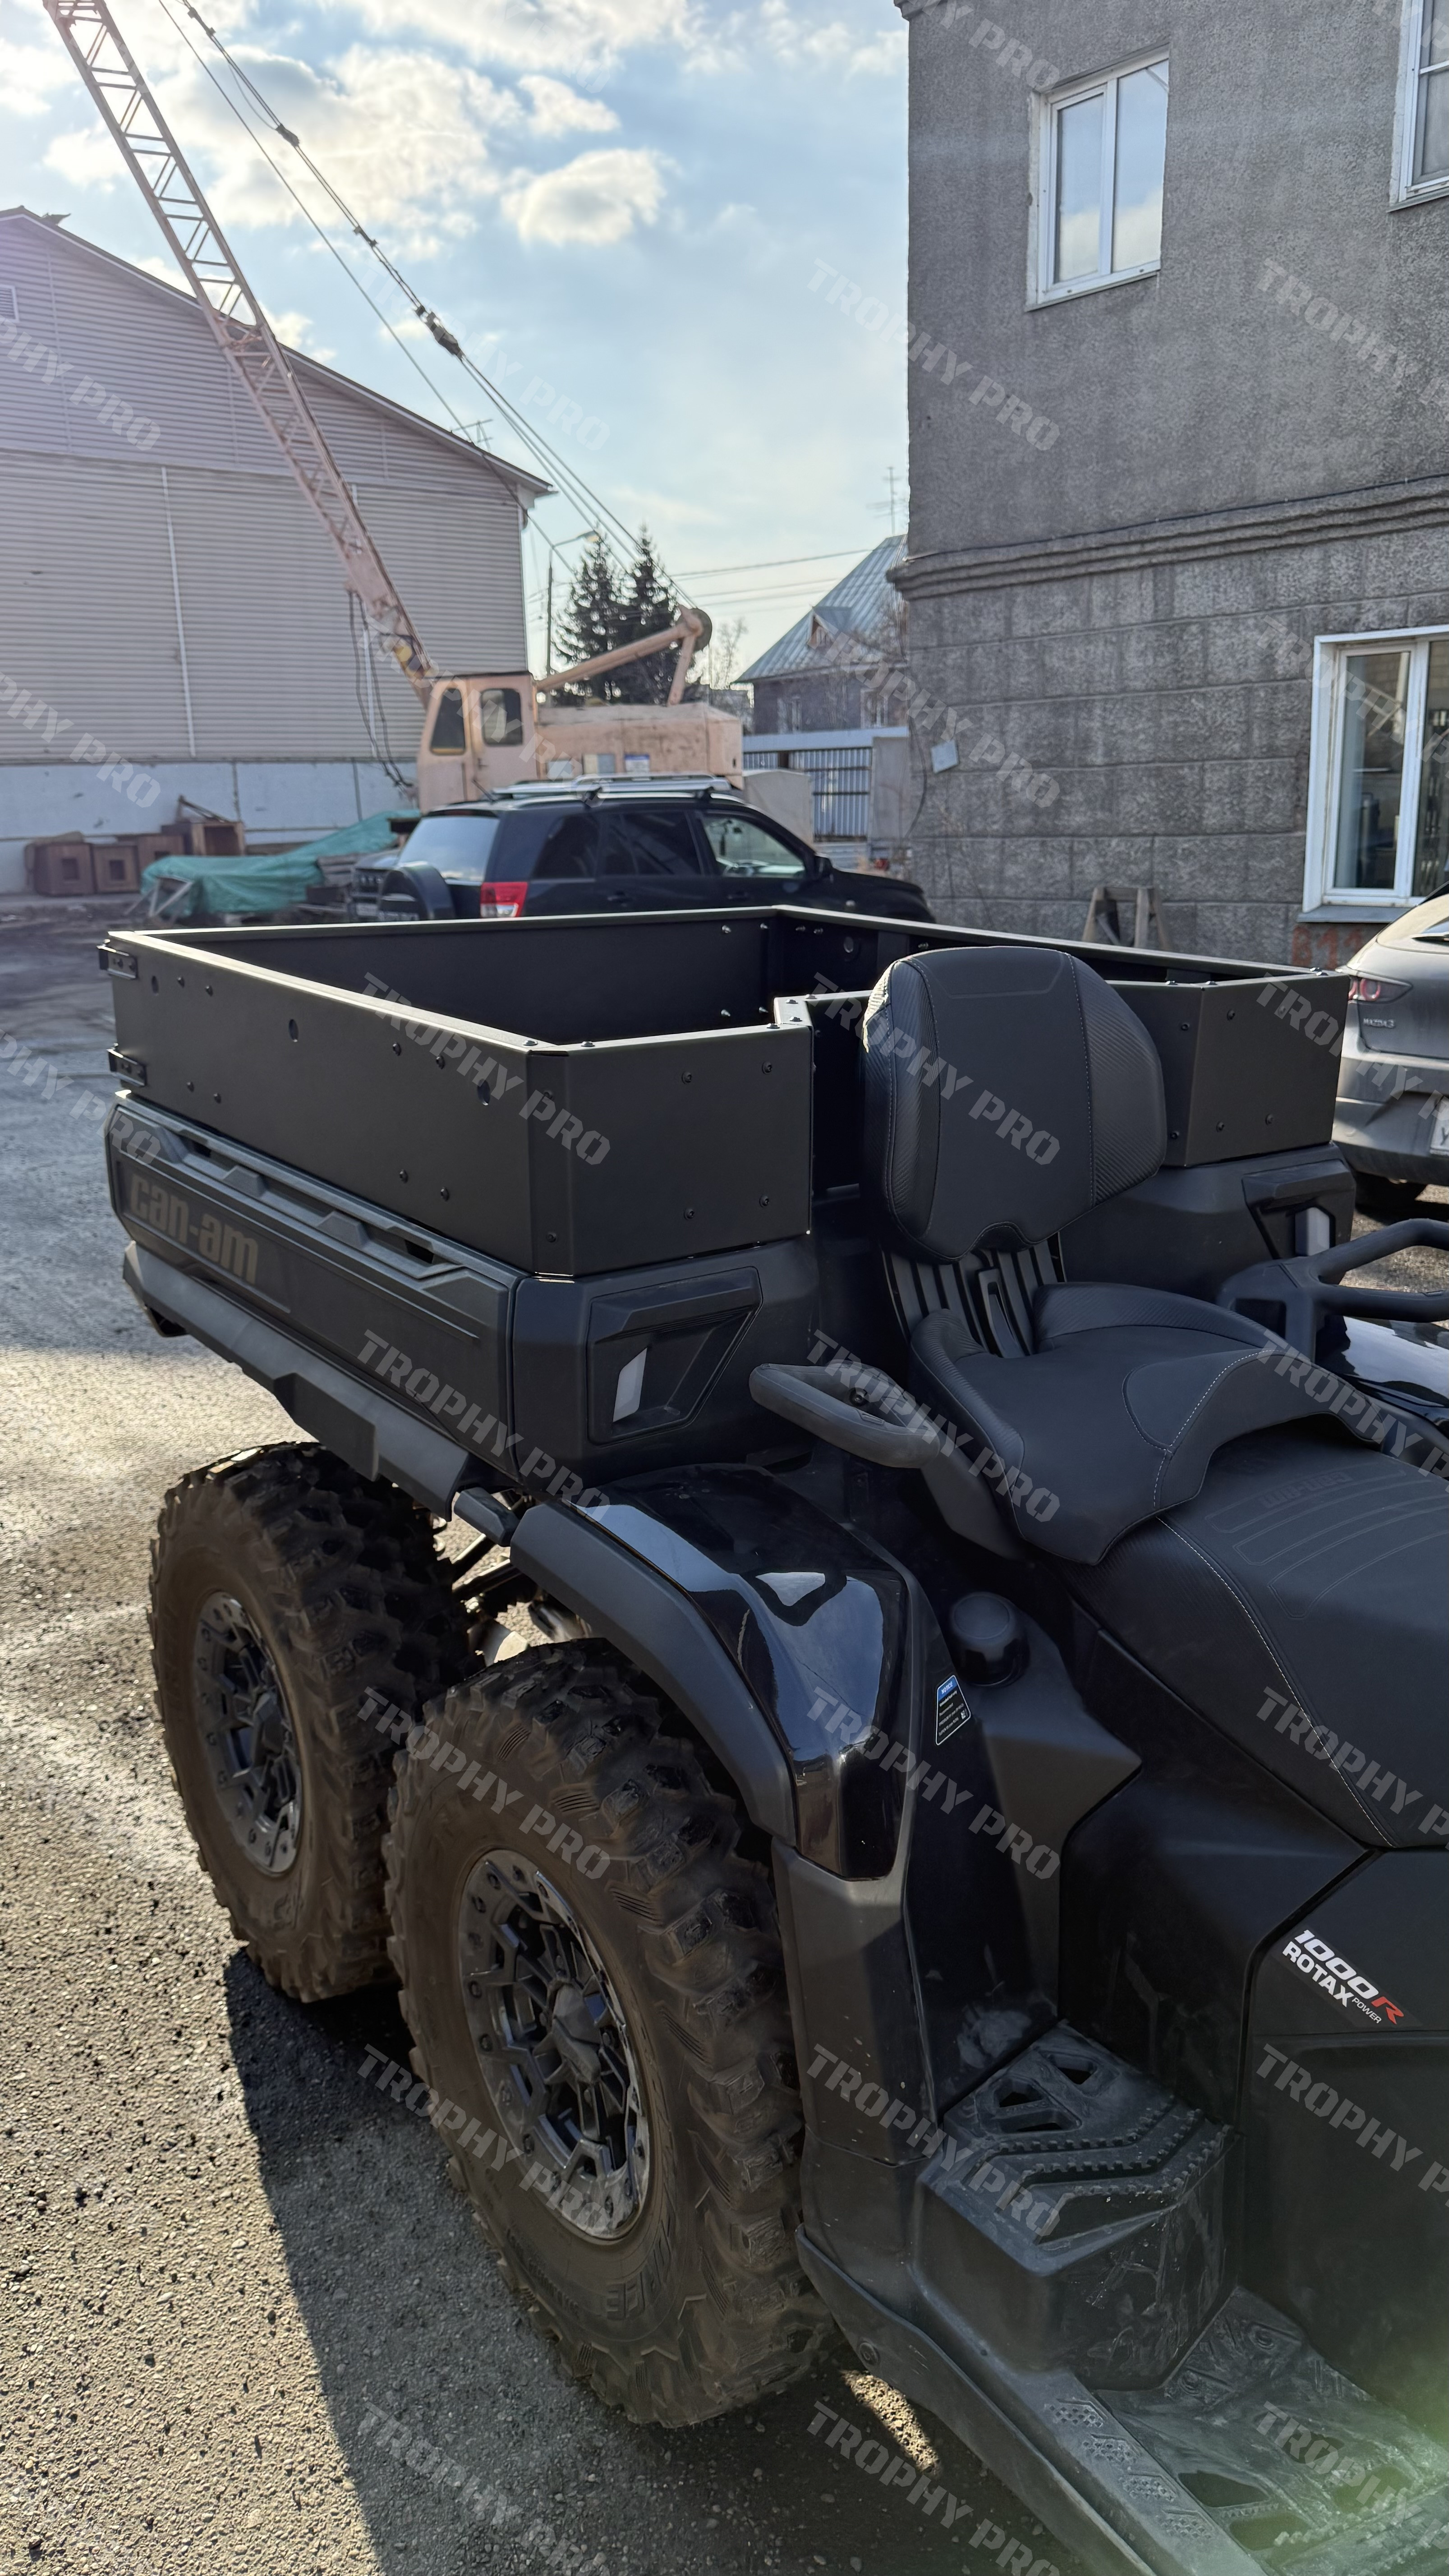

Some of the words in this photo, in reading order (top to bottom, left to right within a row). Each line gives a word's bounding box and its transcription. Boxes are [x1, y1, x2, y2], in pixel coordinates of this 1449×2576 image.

[130, 1174, 258, 1284] can-am
[941, 1681, 953, 1695] NOTICE
[1282, 1941, 1354, 2007] ROTAX
[1352, 1997, 1382, 2024] POWER
[1294, 1929, 1404, 2025] 1000R
